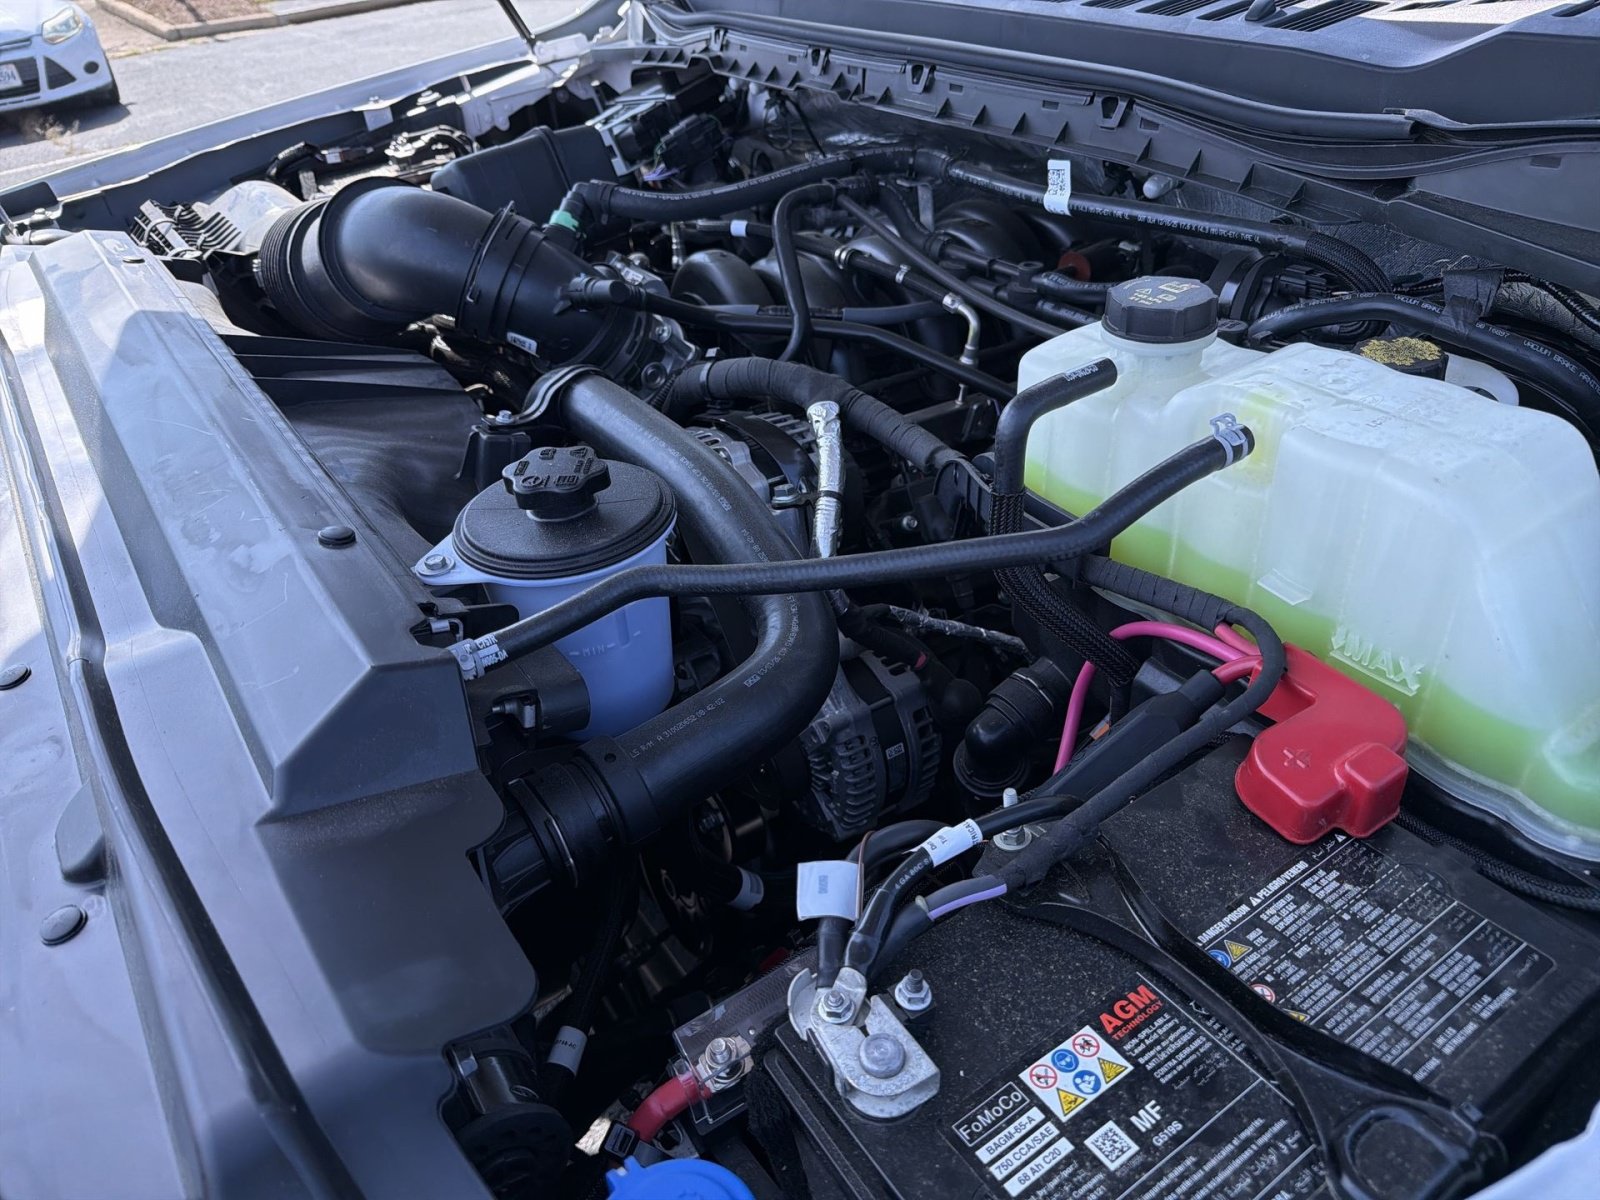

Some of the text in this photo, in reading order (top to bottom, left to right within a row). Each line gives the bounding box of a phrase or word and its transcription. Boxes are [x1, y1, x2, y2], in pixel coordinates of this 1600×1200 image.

[1552, 353, 1577, 372] BRAKE
[582, 643, 604, 655] MIN
[1340, 629, 1425, 689] MAX
[898, 873, 911, 885] GA
[1197, 903, 1250, 943] DANGER/POISON
[1255, 860, 1308, 899] PELIGRO/VENENO
[1098, 981, 1156, 1032] AGM
[1111, 1000, 1163, 1041] TECHNOLOGY
[1122, 1012, 1170, 1050] NON-SPILLABLE
[1143, 1031, 1159, 1044] Acid
[1157, 1017, 1179, 1034] Battery
[1137, 1043, 1162, 1063] Batterie
[1153, 1035, 1206, 1078] CONTRA DERRAMES
[958, 1087, 1023, 1140] FoMoCo
[1129, 1099, 1167, 1132] MF
[985, 1114, 1035, 1155] BAGM-65-A
[994, 1125, 1054, 1175] 750 CCA/SAE
[1151, 1119, 1183, 1147] G519S
[1016, 1146, 1062, 1185] 68 Ah C20
[1166, 1153, 1198, 1180] materials.
[1072, 1171, 1107, 1200] Company.
